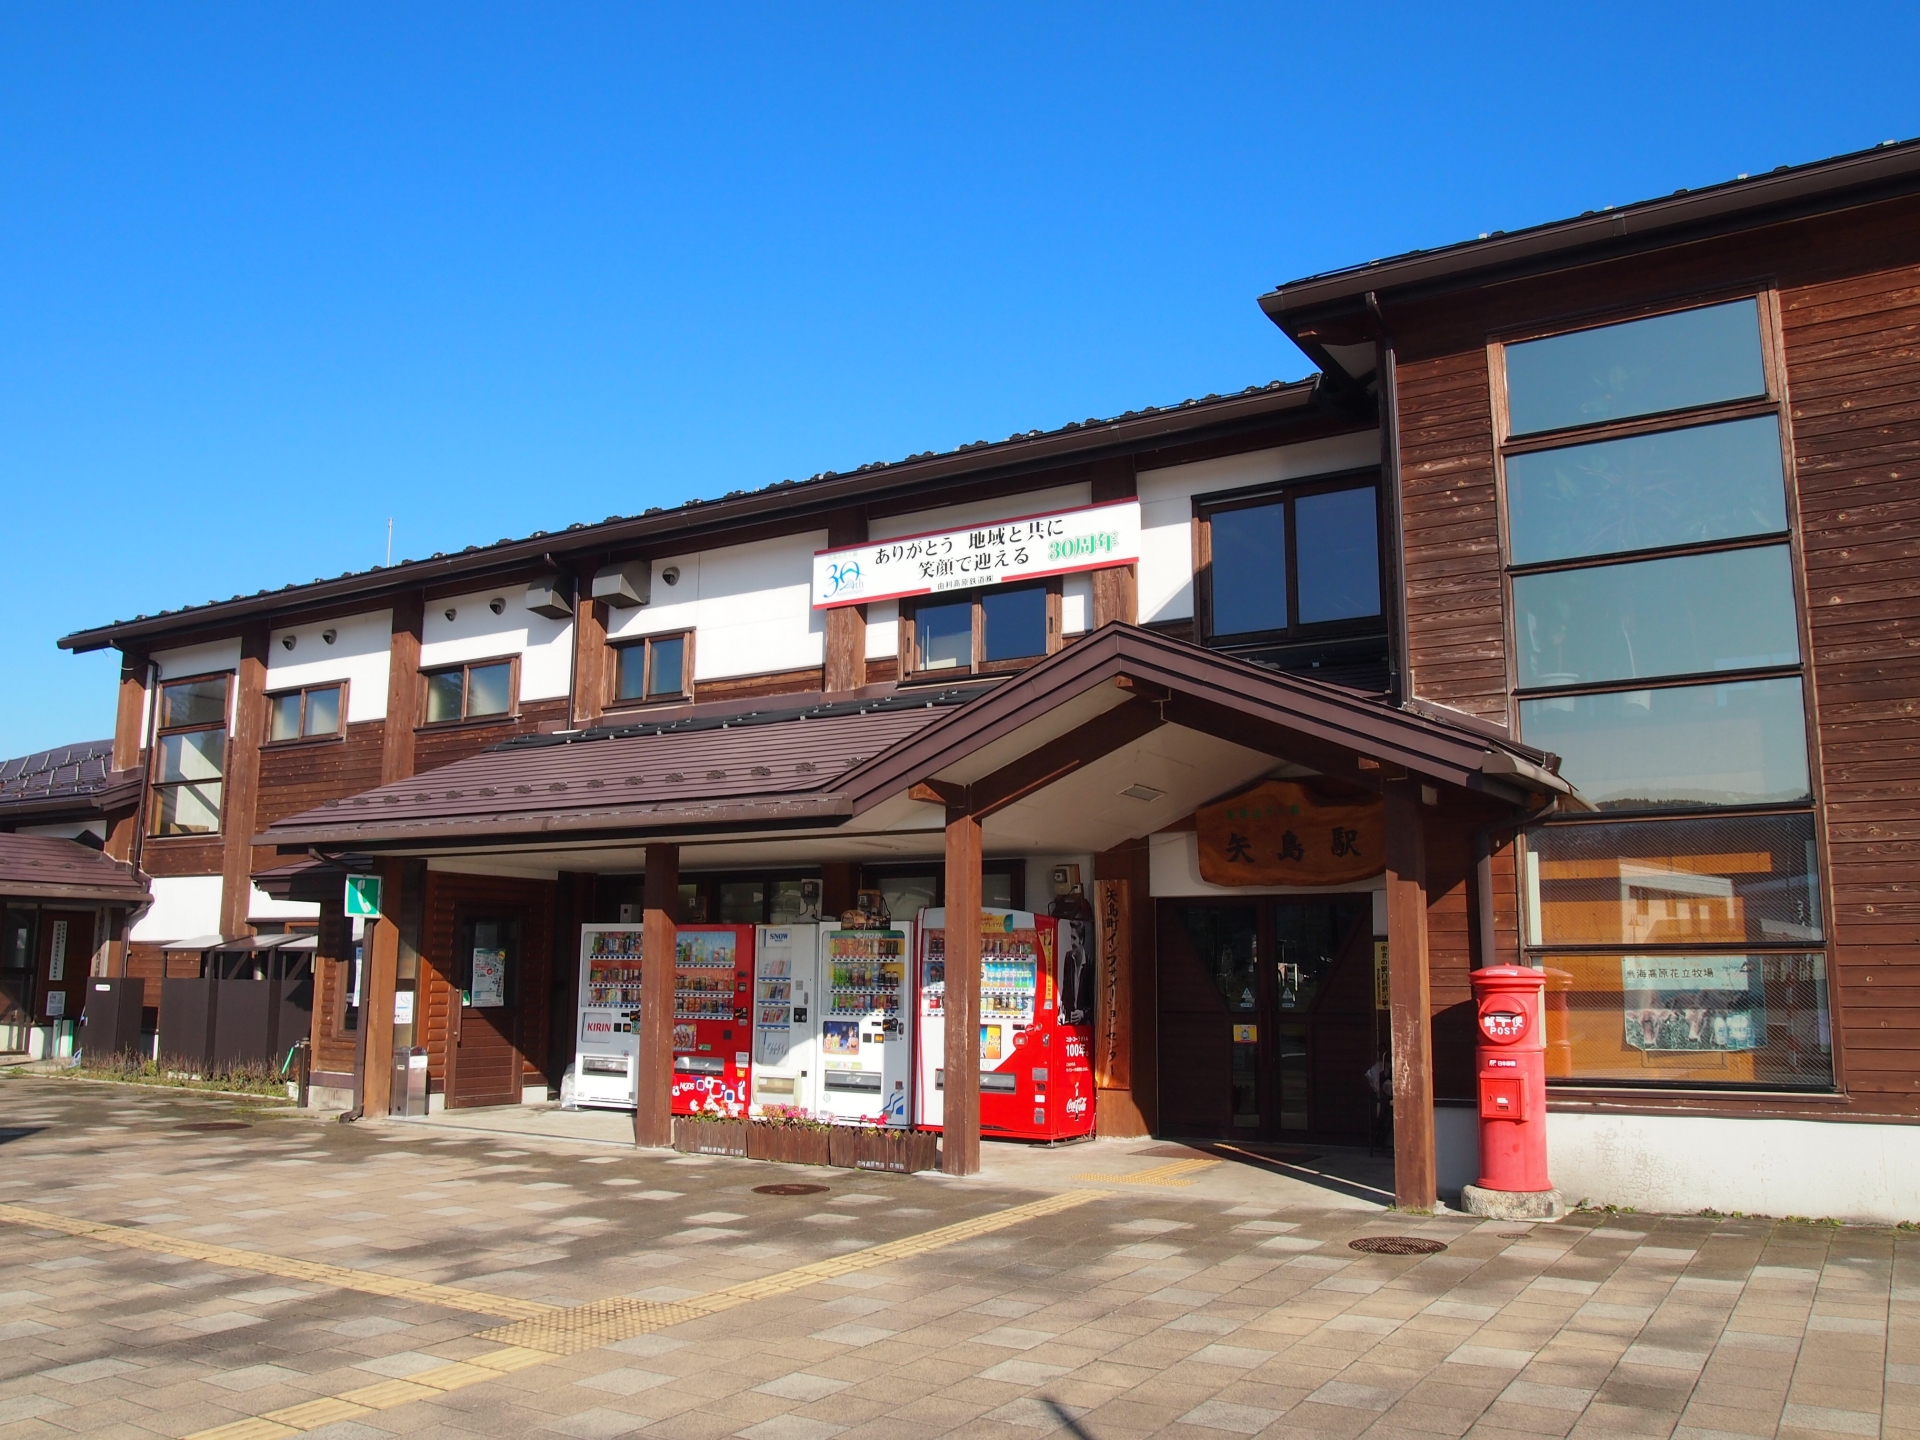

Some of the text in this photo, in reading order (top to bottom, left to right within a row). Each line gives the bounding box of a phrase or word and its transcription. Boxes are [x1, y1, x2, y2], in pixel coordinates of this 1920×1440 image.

[875, 518, 1064, 565] ありがとう 地域と共に
[1048, 531, 1119, 561] 30周年
[918, 546, 1030, 580] 笑顔で迎える
[1226, 826, 1362, 863] 矢島駅
[769, 932, 789, 940] SNOW
[1105, 886, 1120, 1077] 矢島町インフォメーションセンター
[587, 1022, 611, 1033] KIRIN
[1489, 1027, 1518, 1035] POST
